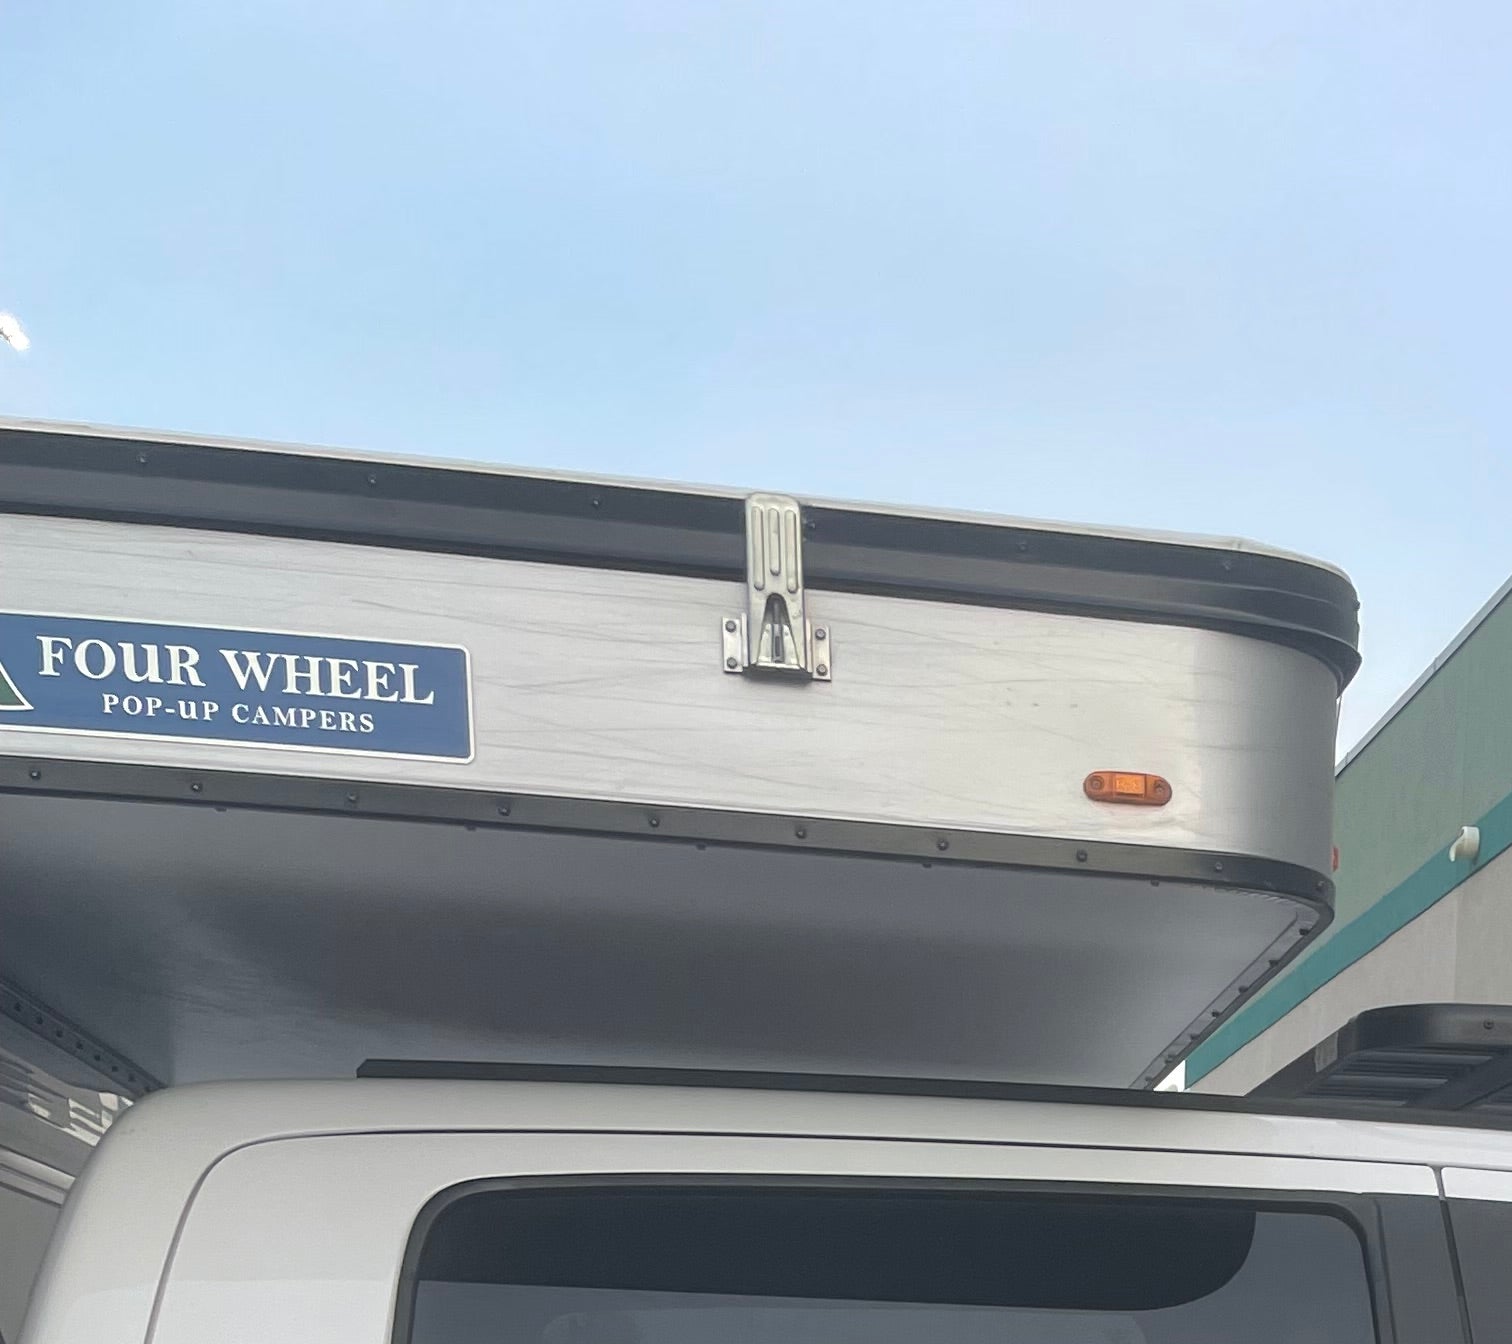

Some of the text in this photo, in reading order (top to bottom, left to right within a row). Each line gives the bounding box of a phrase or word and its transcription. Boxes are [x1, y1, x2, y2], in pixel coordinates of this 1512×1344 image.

[36, 635, 435, 705] FOUR WHEEL
[102, 693, 375, 733] POP-UP CAMPERS
